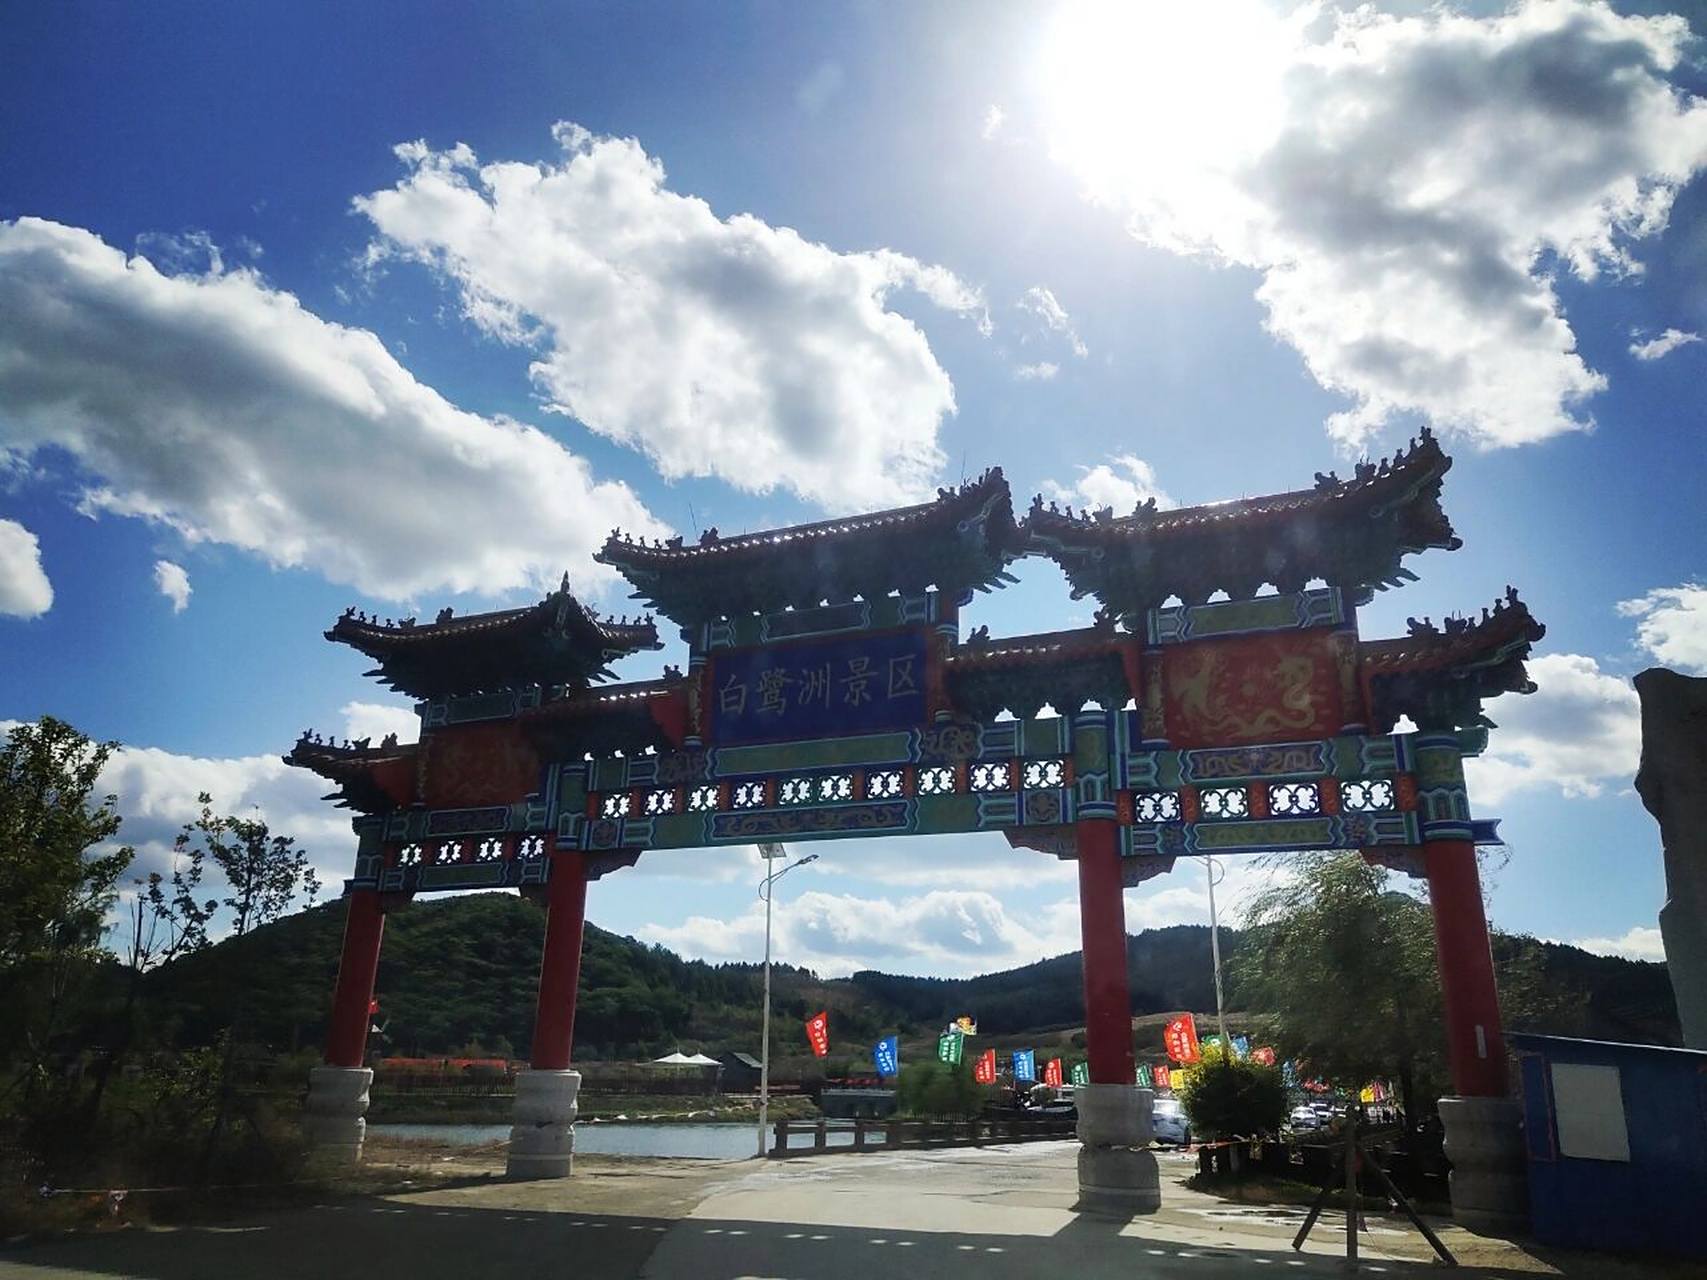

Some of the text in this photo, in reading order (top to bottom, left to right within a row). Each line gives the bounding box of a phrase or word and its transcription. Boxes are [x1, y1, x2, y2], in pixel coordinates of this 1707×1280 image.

[719, 653, 919, 716] 白鹭洲景区
